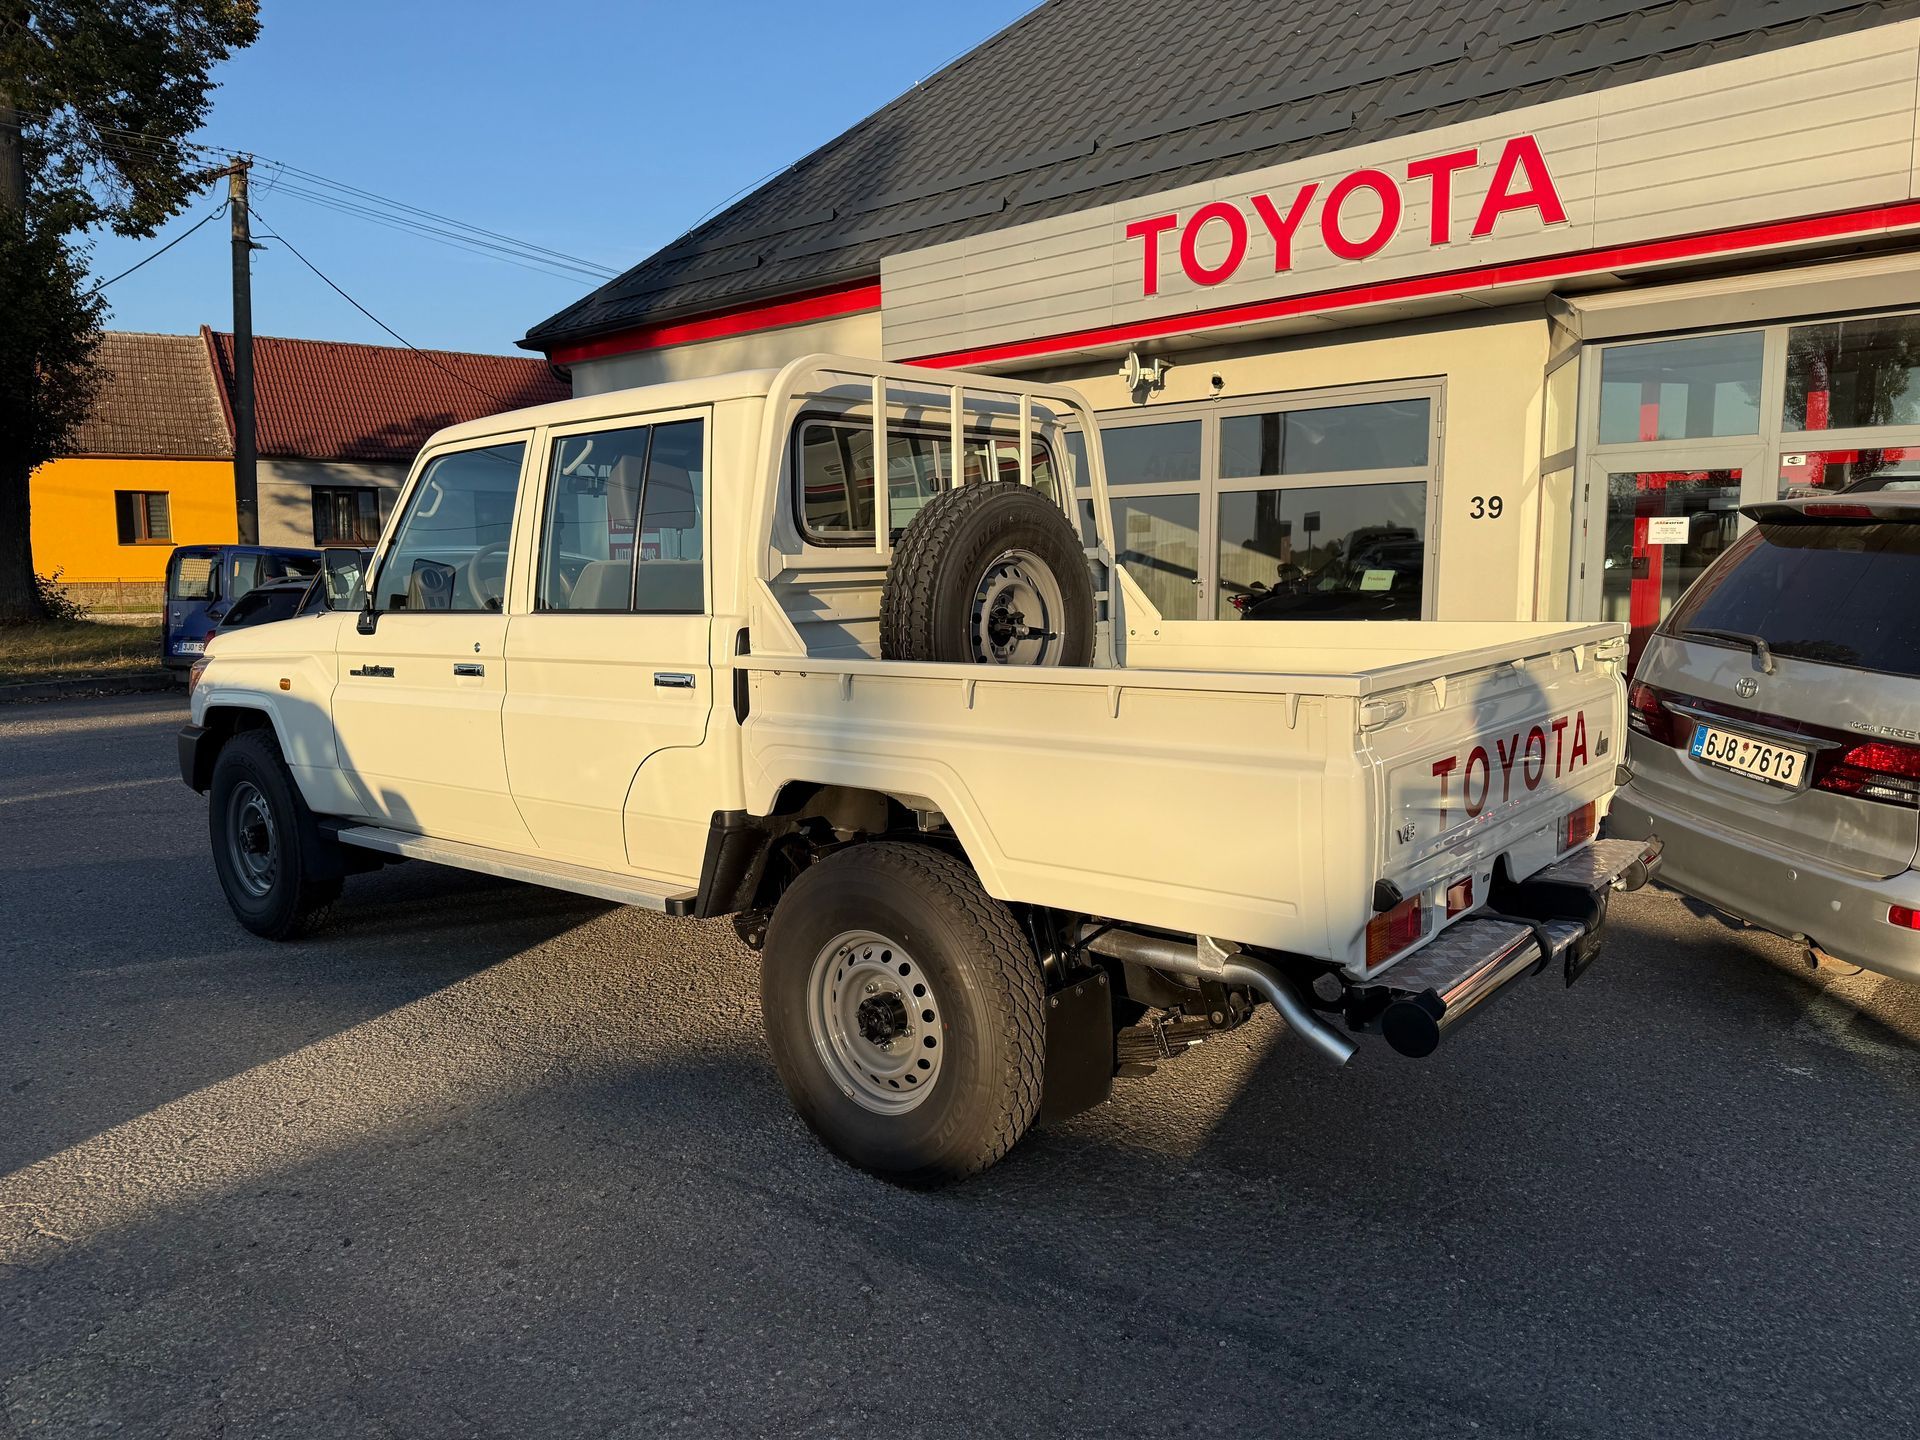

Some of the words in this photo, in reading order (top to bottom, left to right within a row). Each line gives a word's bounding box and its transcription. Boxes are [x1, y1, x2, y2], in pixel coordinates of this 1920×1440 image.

[1126, 133, 1570, 297] TOYOTA
[1470, 495, 1503, 519] 39
[1694, 744, 1703, 753] CZ
[1849, 721, 1878, 733] TOYOTA
[1880, 725, 1920, 741] PRE
[1431, 710, 1588, 832] TOYOTA
[1706, 732, 1738, 762] 6J8
[1747, 744, 1795, 779] 7613
